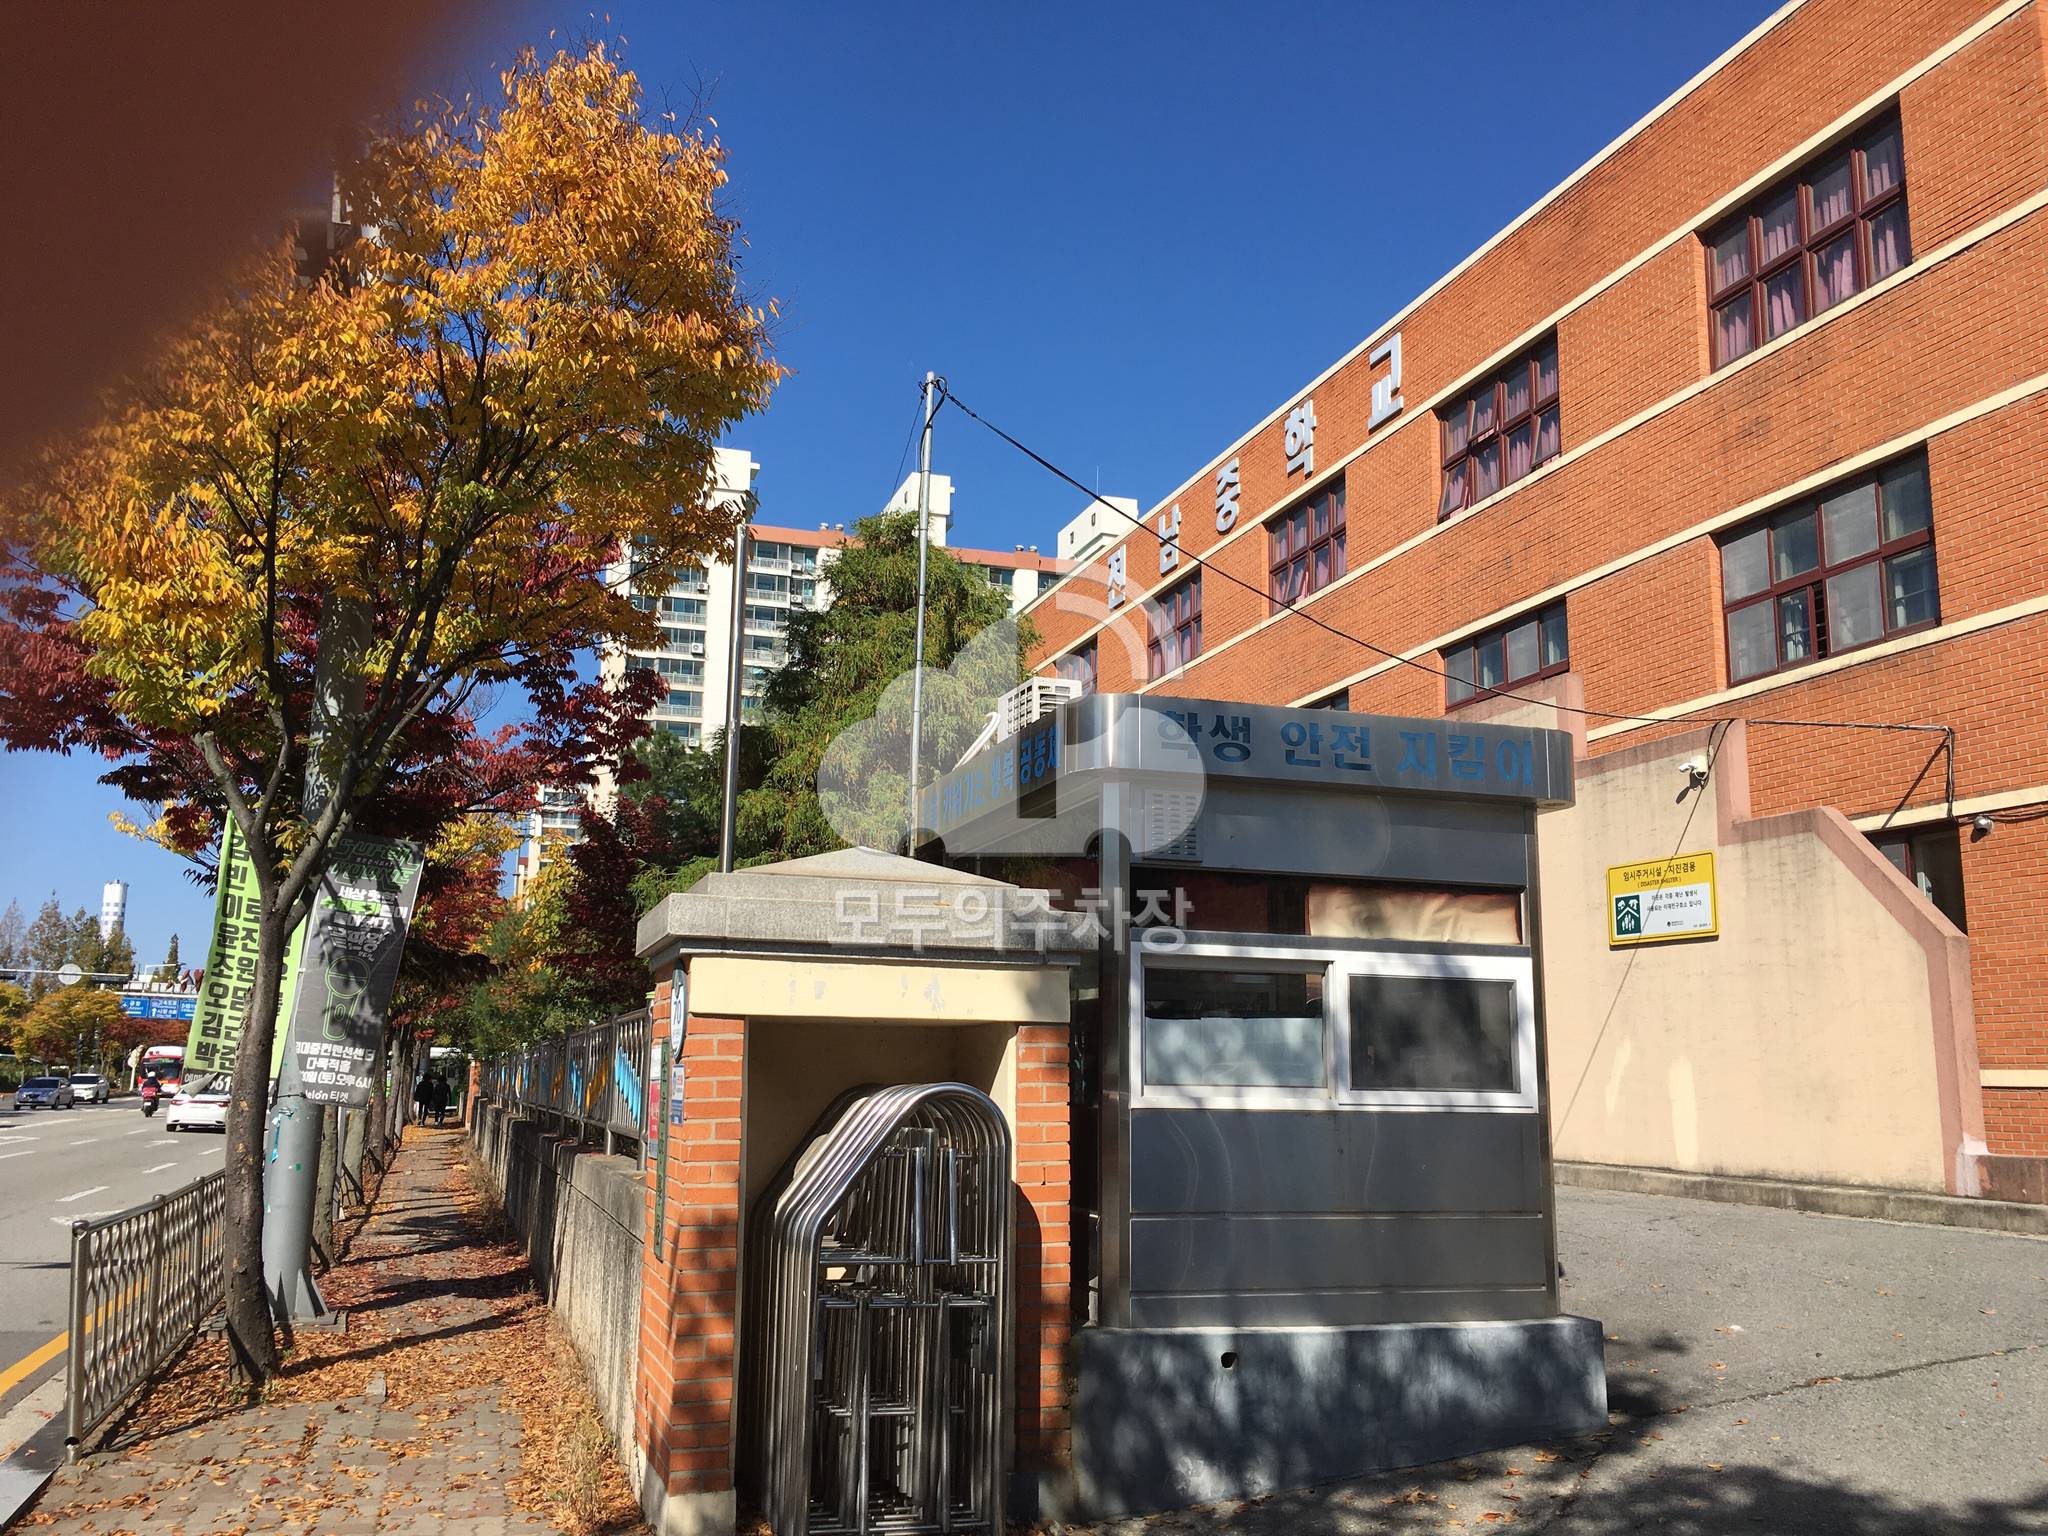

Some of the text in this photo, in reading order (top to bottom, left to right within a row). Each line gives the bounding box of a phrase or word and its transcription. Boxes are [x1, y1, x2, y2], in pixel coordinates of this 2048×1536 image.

[1157, 709, 1533, 786] 학생 안전 지킴이
[1623, 866, 1662, 882] 임시주거시설
[306, 1057, 352, 1074] 다목적홀
[335, 1073, 356, 1087] 오후
[330, 1091, 349, 1102] 티켓
